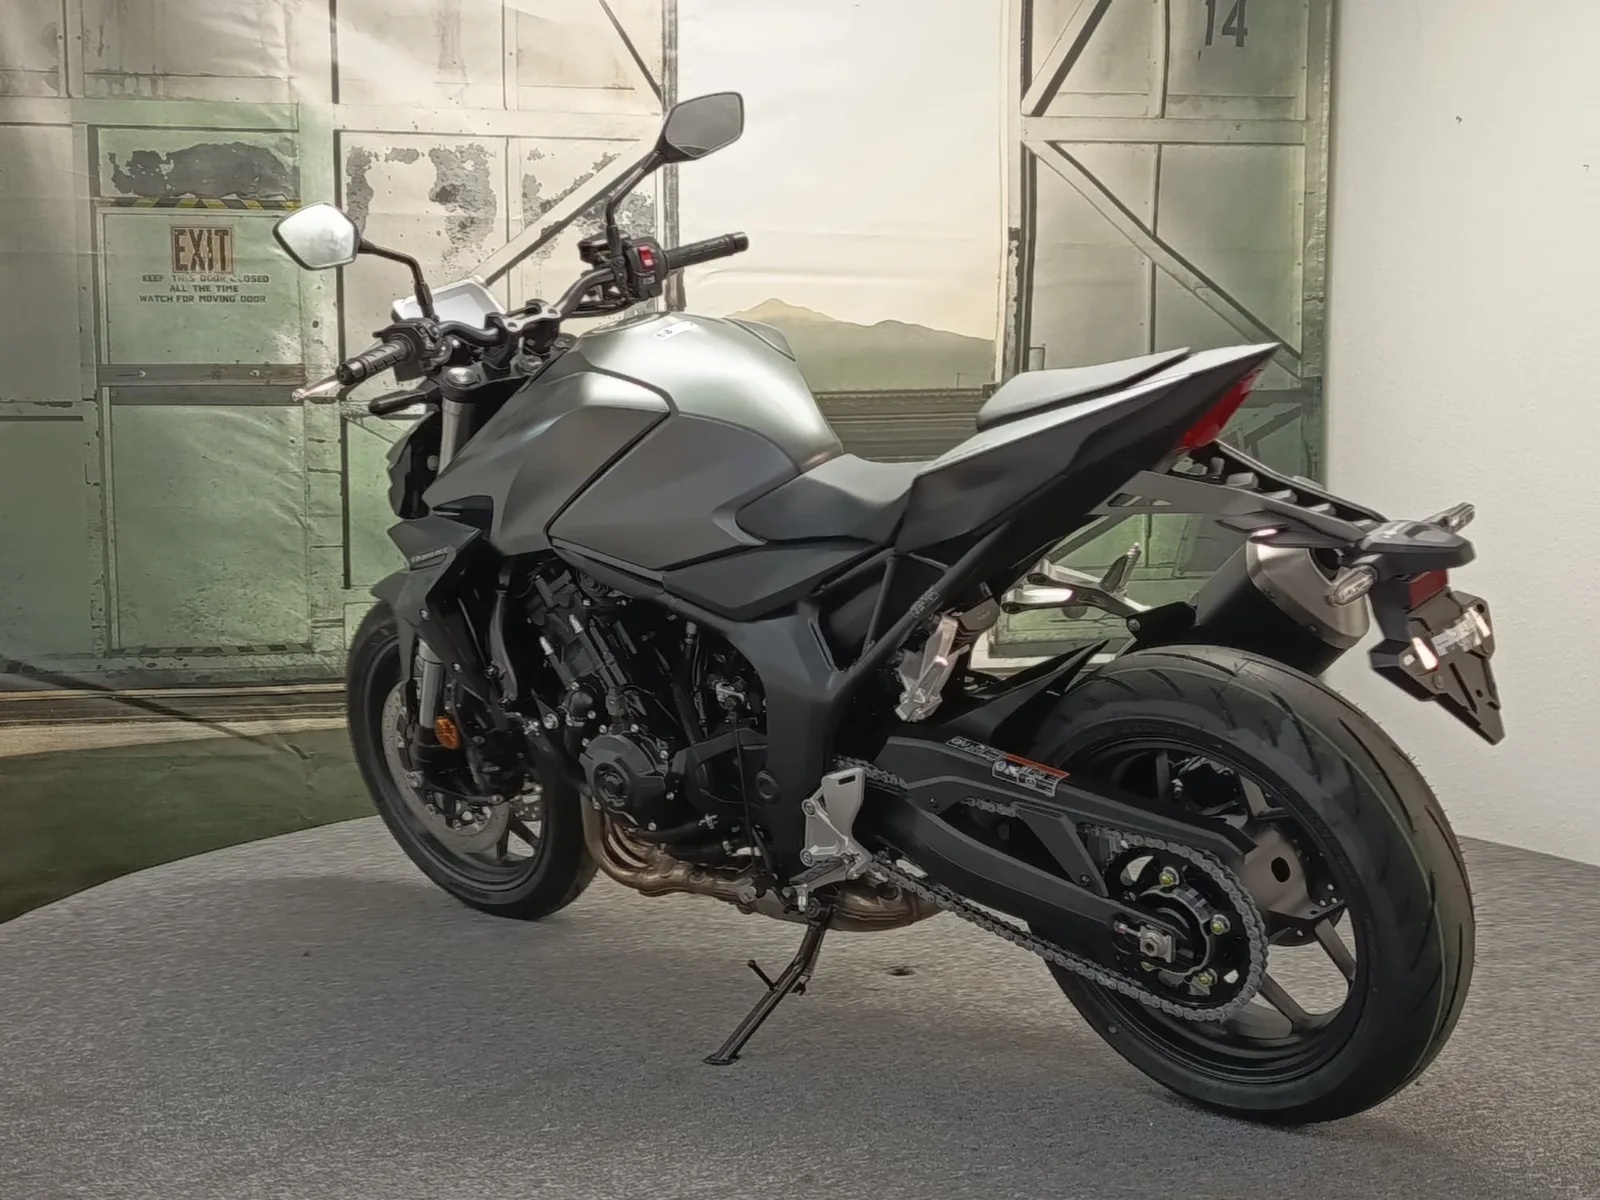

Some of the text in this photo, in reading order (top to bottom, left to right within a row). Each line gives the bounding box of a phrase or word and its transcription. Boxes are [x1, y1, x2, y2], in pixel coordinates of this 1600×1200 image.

[1204, 0, 1248, 48] 14
[173, 229, 229, 271] EXIT
[141, 274, 165, 282] KEEP
[169, 284, 240, 293] ALL THE TIME
[139, 294, 267, 303] WATCH FOR MOVING DOOR
